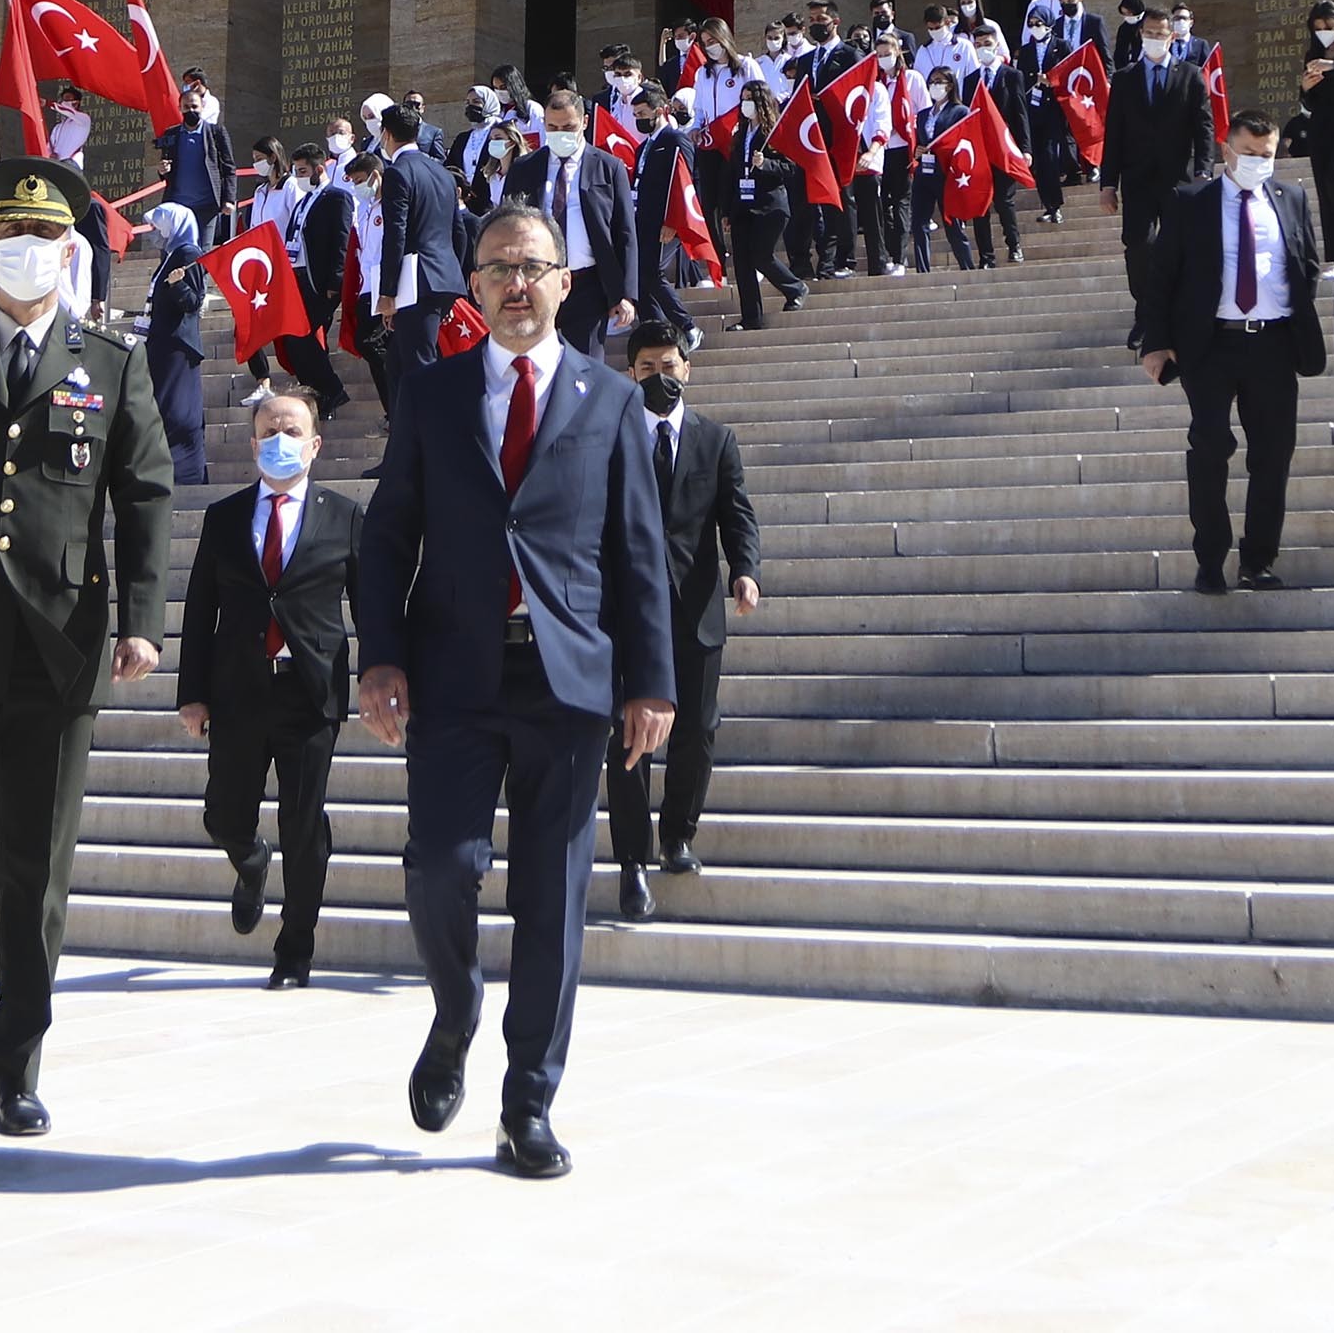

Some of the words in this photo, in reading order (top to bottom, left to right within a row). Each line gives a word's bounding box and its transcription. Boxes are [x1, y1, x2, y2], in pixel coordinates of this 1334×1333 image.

[1256, 30, 1286, 44] TAM
[282, 46, 310, 59] DAHA
[1259, 61, 1292, 75] DAHA
[129, 171, 141, 183] VE
